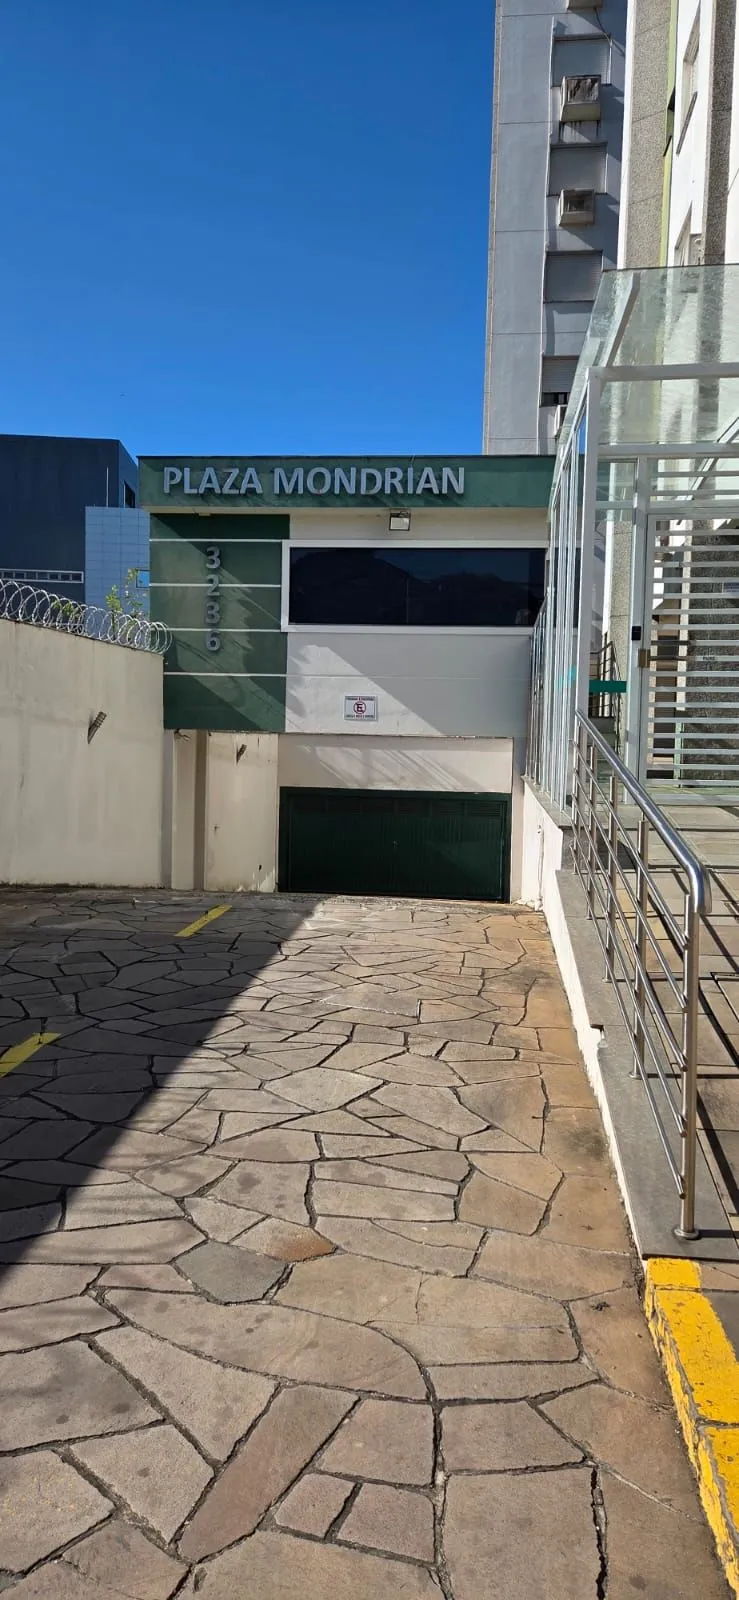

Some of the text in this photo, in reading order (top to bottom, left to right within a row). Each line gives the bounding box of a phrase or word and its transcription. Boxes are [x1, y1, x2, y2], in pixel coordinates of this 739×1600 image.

[163, 466, 465, 495] PLAZA MONDRIAN
[205, 546, 221, 652] 3236
